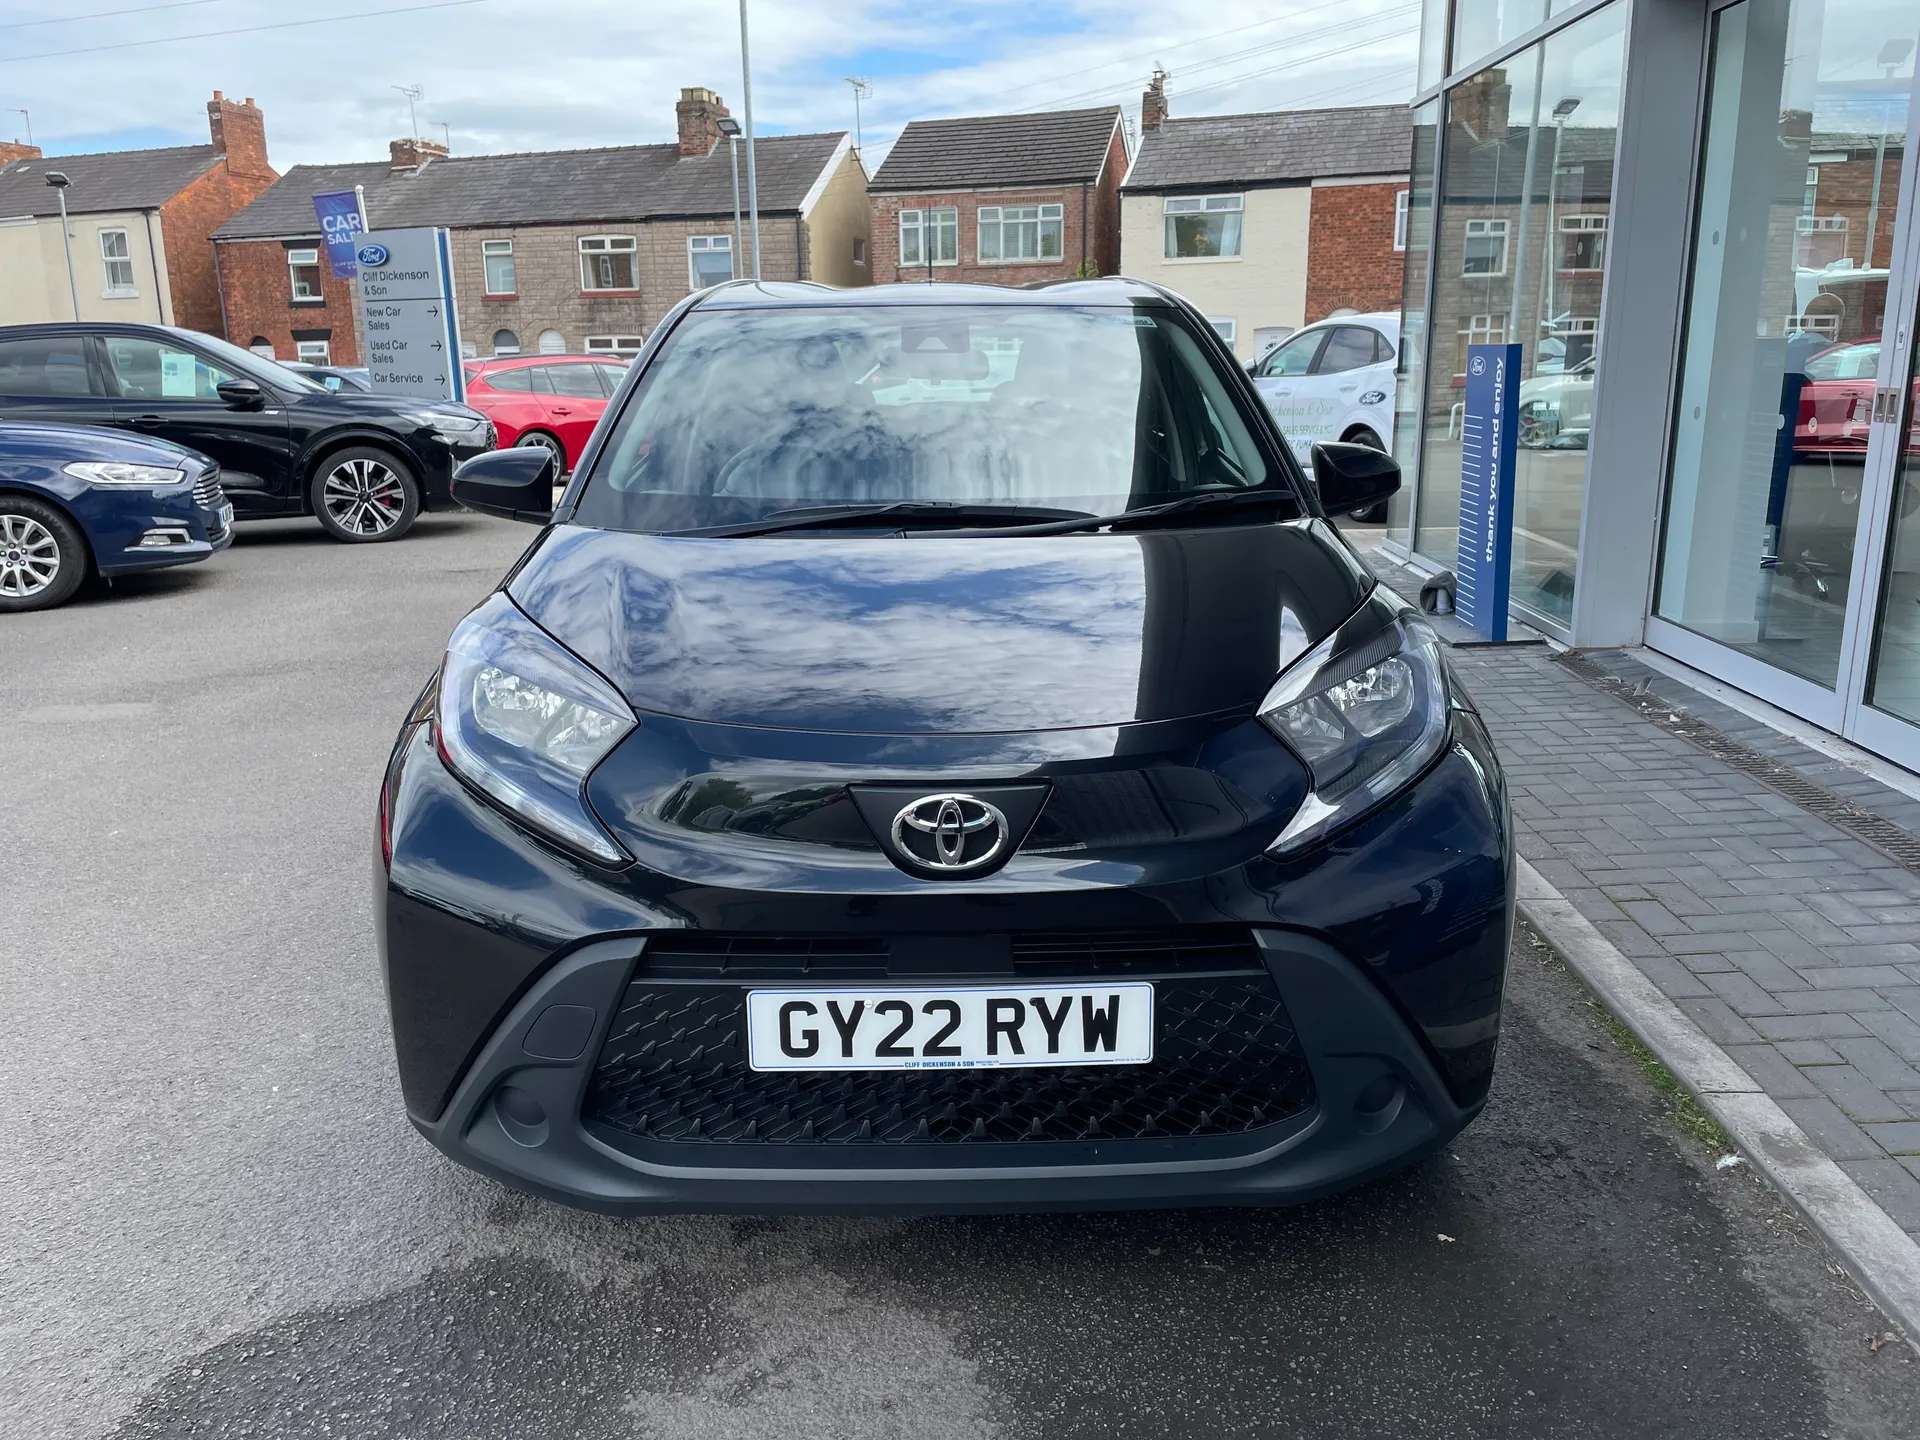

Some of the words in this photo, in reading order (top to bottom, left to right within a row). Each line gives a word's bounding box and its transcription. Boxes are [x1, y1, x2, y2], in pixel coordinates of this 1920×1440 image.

[323, 213, 361, 232] CAR
[328, 231, 361, 245] SALE
[362, 271, 378, 282] Cliff
[379, 270, 430, 281] Dickenson
[364, 285, 370, 296] &
[370, 284, 388, 296] Son
[366, 307, 384, 318] New
[385, 306, 401, 317] Car
[368, 320, 390, 331] Sales
[370, 340, 391, 351] Used
[391, 339, 408, 350] Car
[371, 353, 394, 364] Sales
[374, 372, 388, 383] Car
[389, 372, 424, 383] Service
[1494, 356, 1504, 415] enjoy
[1492, 418, 1500, 459] and
[1485, 503, 1495, 563] thank
[779, 999, 962, 1059] GY22
[986, 994, 1121, 1056] RYW
